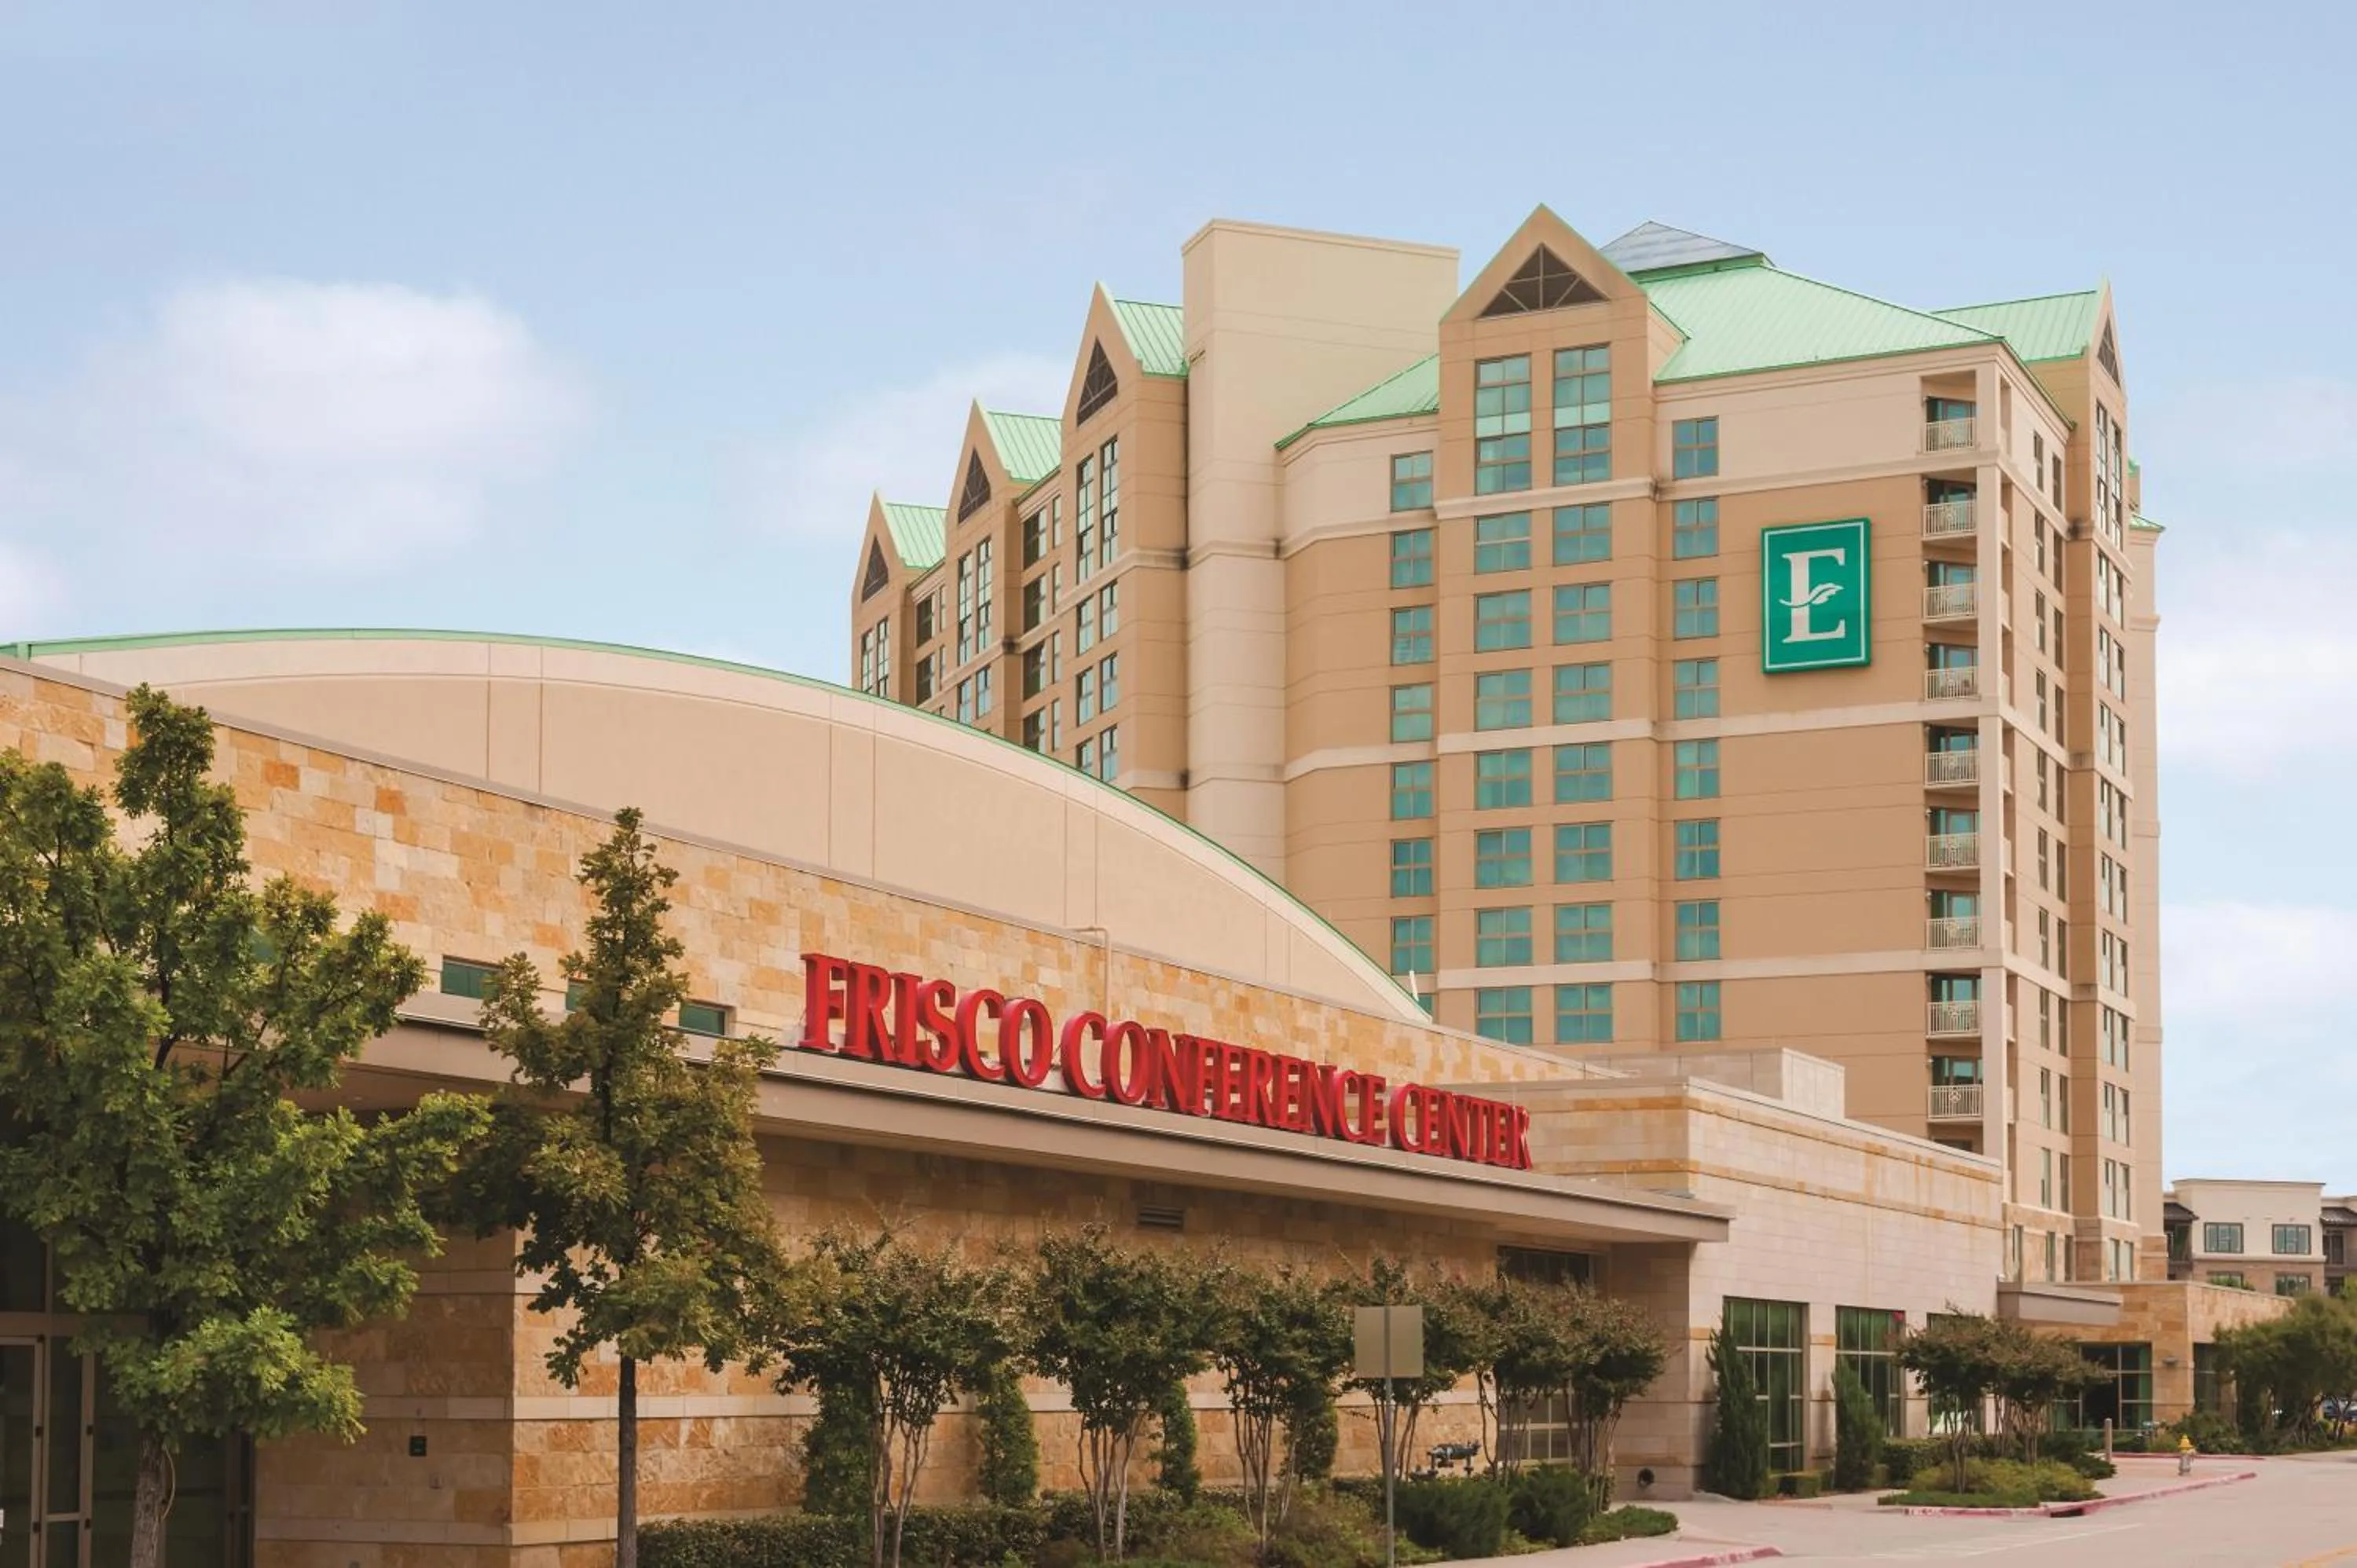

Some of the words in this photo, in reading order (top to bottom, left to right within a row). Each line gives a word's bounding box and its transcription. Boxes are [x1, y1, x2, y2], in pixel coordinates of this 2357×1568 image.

[1780, 548, 1846, 643] E
[798, 953, 1054, 1089] FRISCO
[1061, 1010, 1387, 1145] CONFERENCE
[1388, 1083, 1532, 1170] CENTER
